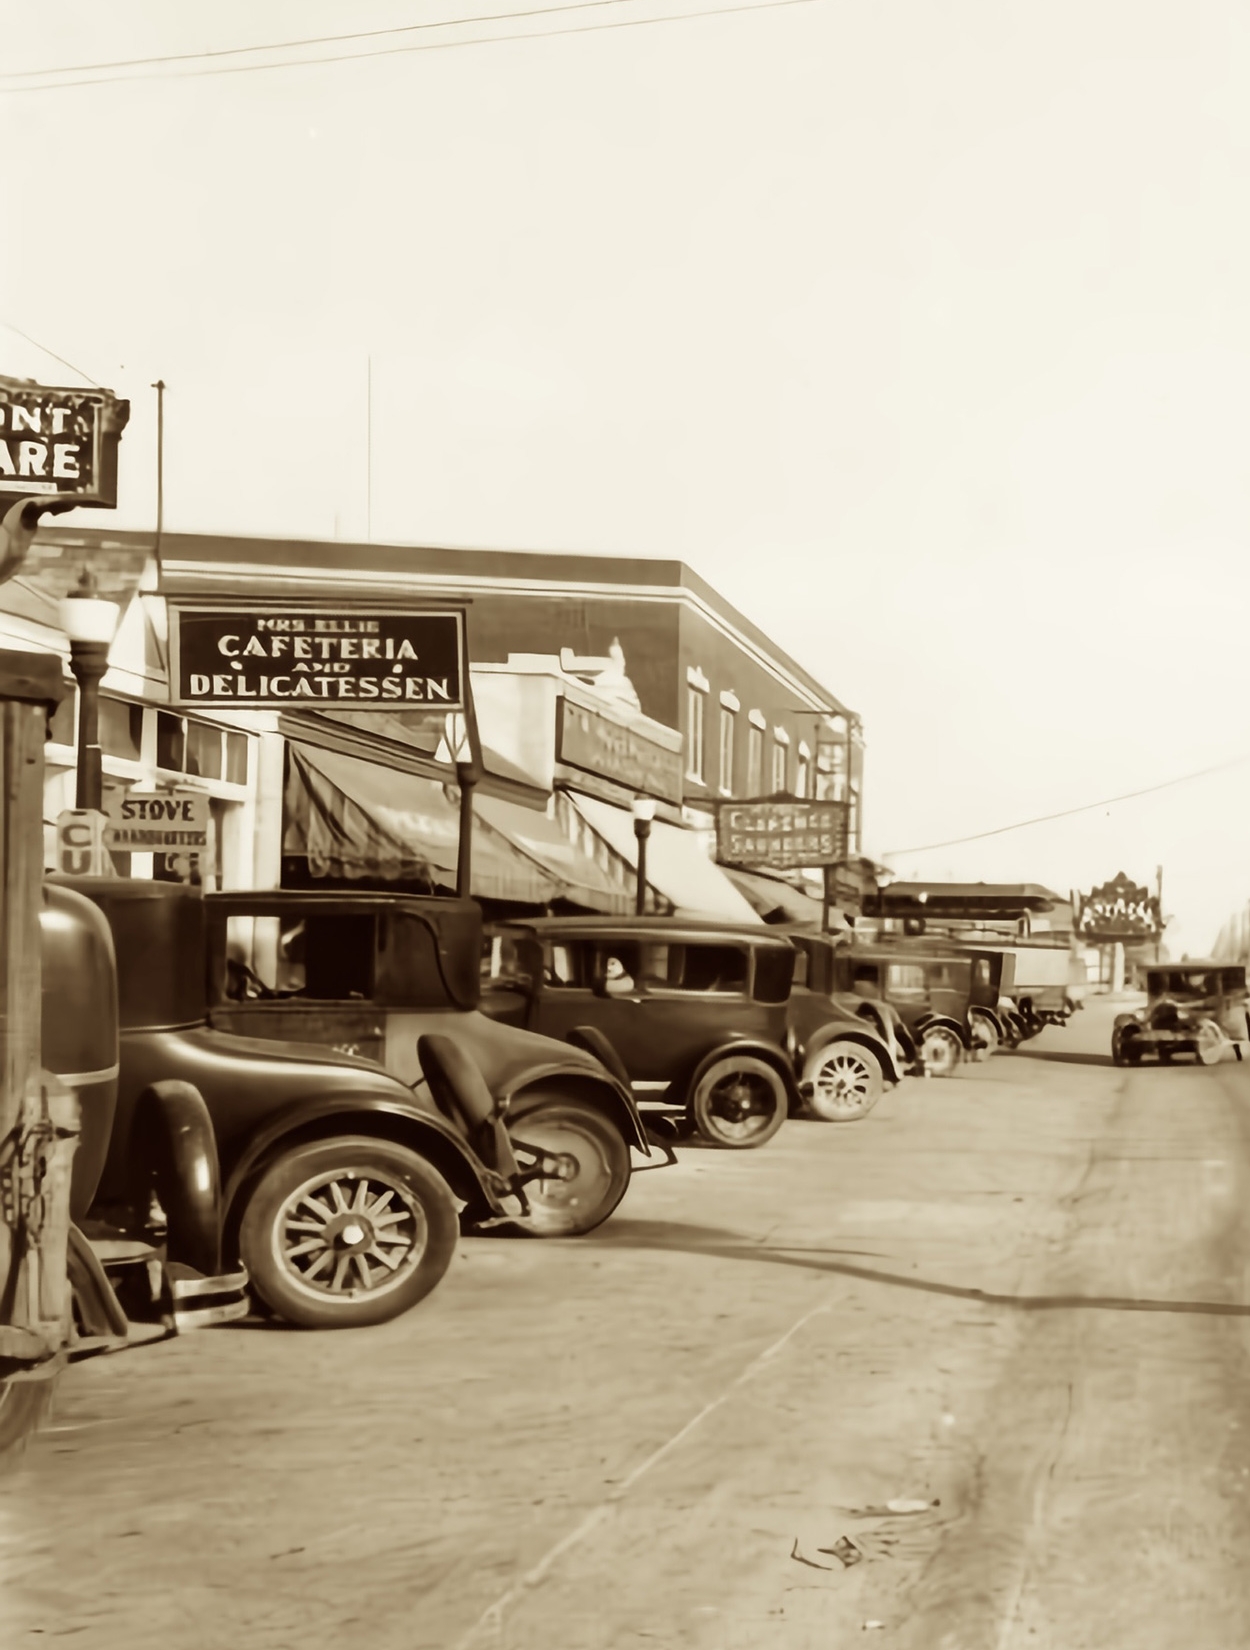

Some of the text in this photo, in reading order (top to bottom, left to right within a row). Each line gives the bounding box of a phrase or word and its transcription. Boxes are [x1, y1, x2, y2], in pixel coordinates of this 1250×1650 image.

[217, 635, 419, 660] CAFETERIA
[291, 661, 352, 673] AND
[189, 674, 451, 700] DELICATESSEN
[121, 800, 196, 822] STOVE
